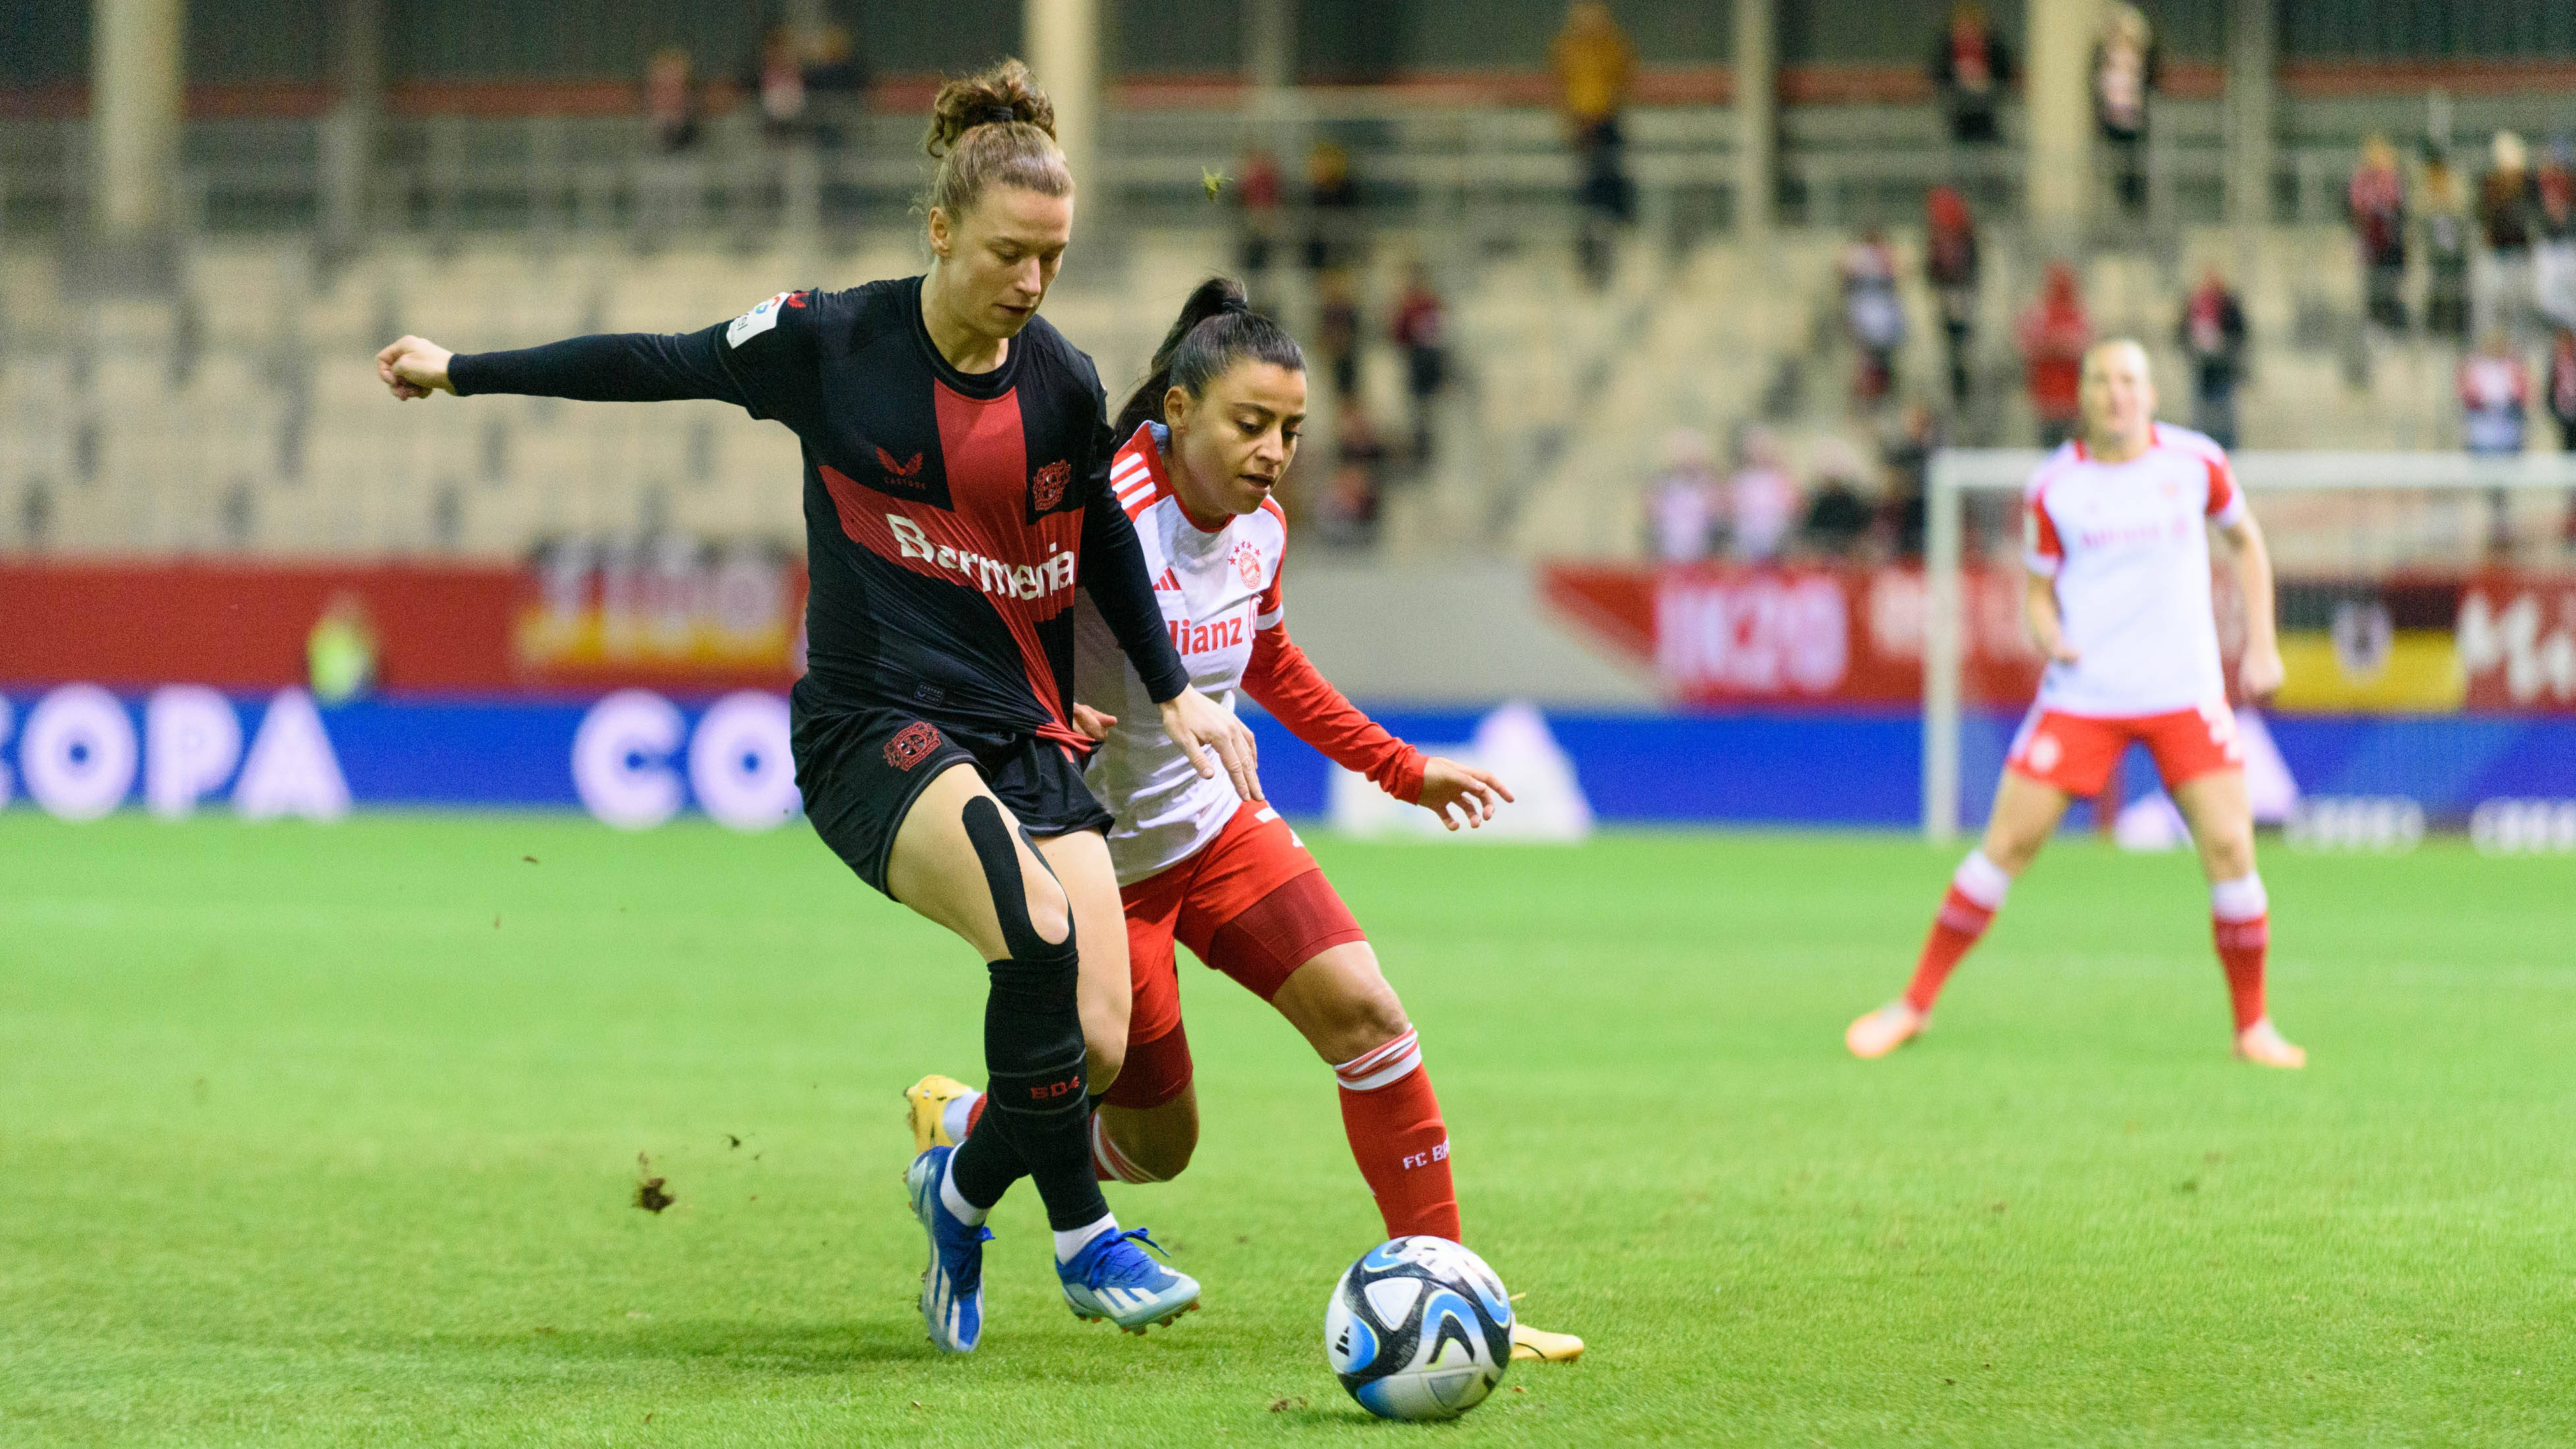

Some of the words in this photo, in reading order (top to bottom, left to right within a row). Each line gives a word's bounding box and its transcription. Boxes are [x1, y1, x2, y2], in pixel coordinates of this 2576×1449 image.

[885, 514, 1074, 601] Barmenia
[1168, 616, 1242, 656] lianz
[0, 682, 351, 821] OPA
[1402, 1152, 1427, 1170] FC
